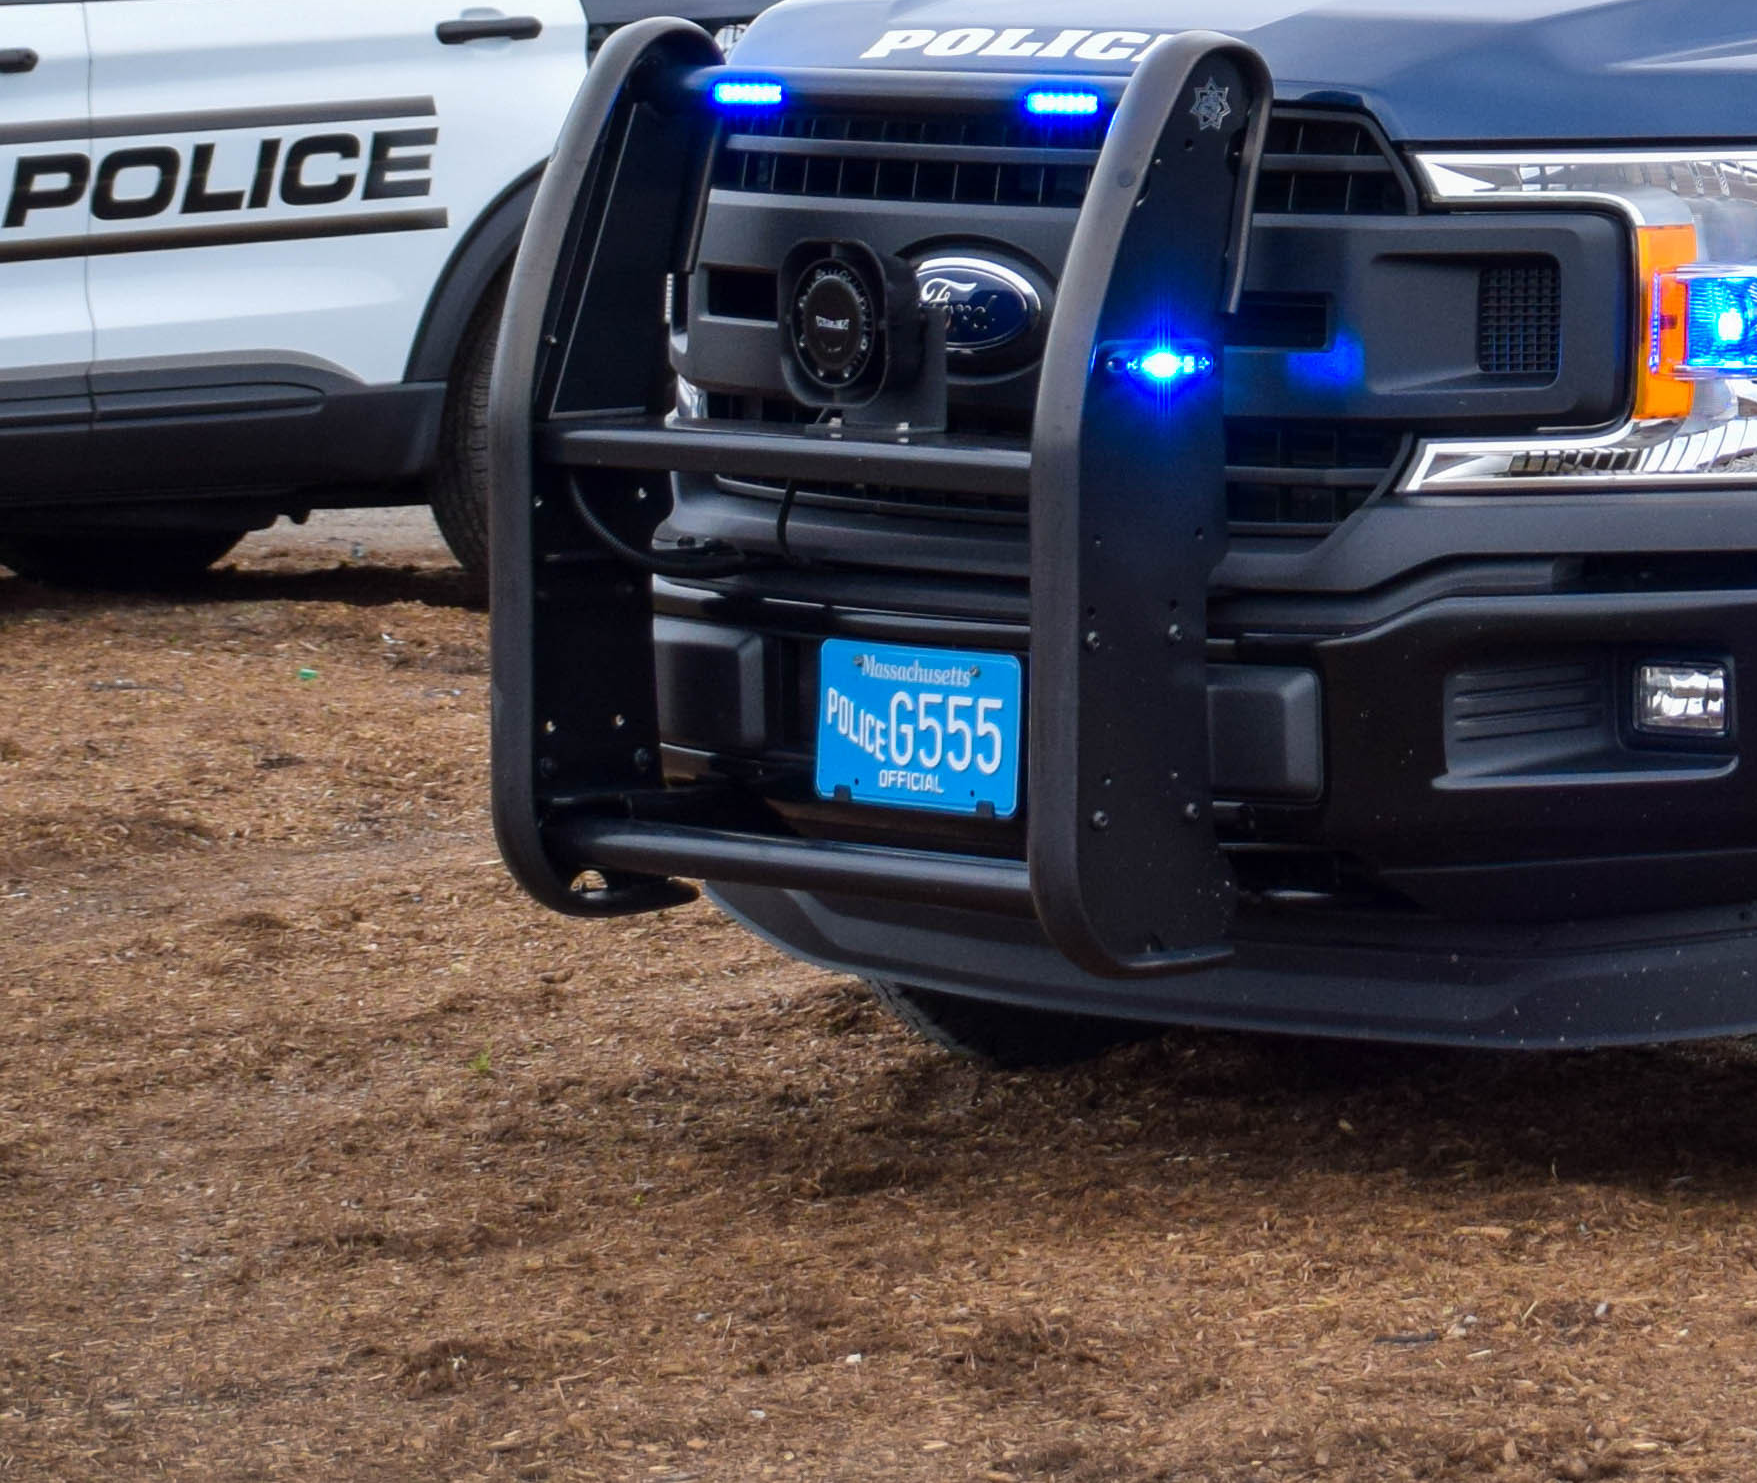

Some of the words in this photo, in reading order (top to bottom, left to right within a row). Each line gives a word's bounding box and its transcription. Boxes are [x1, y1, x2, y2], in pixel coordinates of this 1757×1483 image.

[2, 127, 439, 228] POLICE
[860, 653, 971, 688] Massachusetts
[826, 686, 887, 763] POLICE
[888, 691, 1003, 775] G555
[877, 769, 945, 794] OFFICIAL
